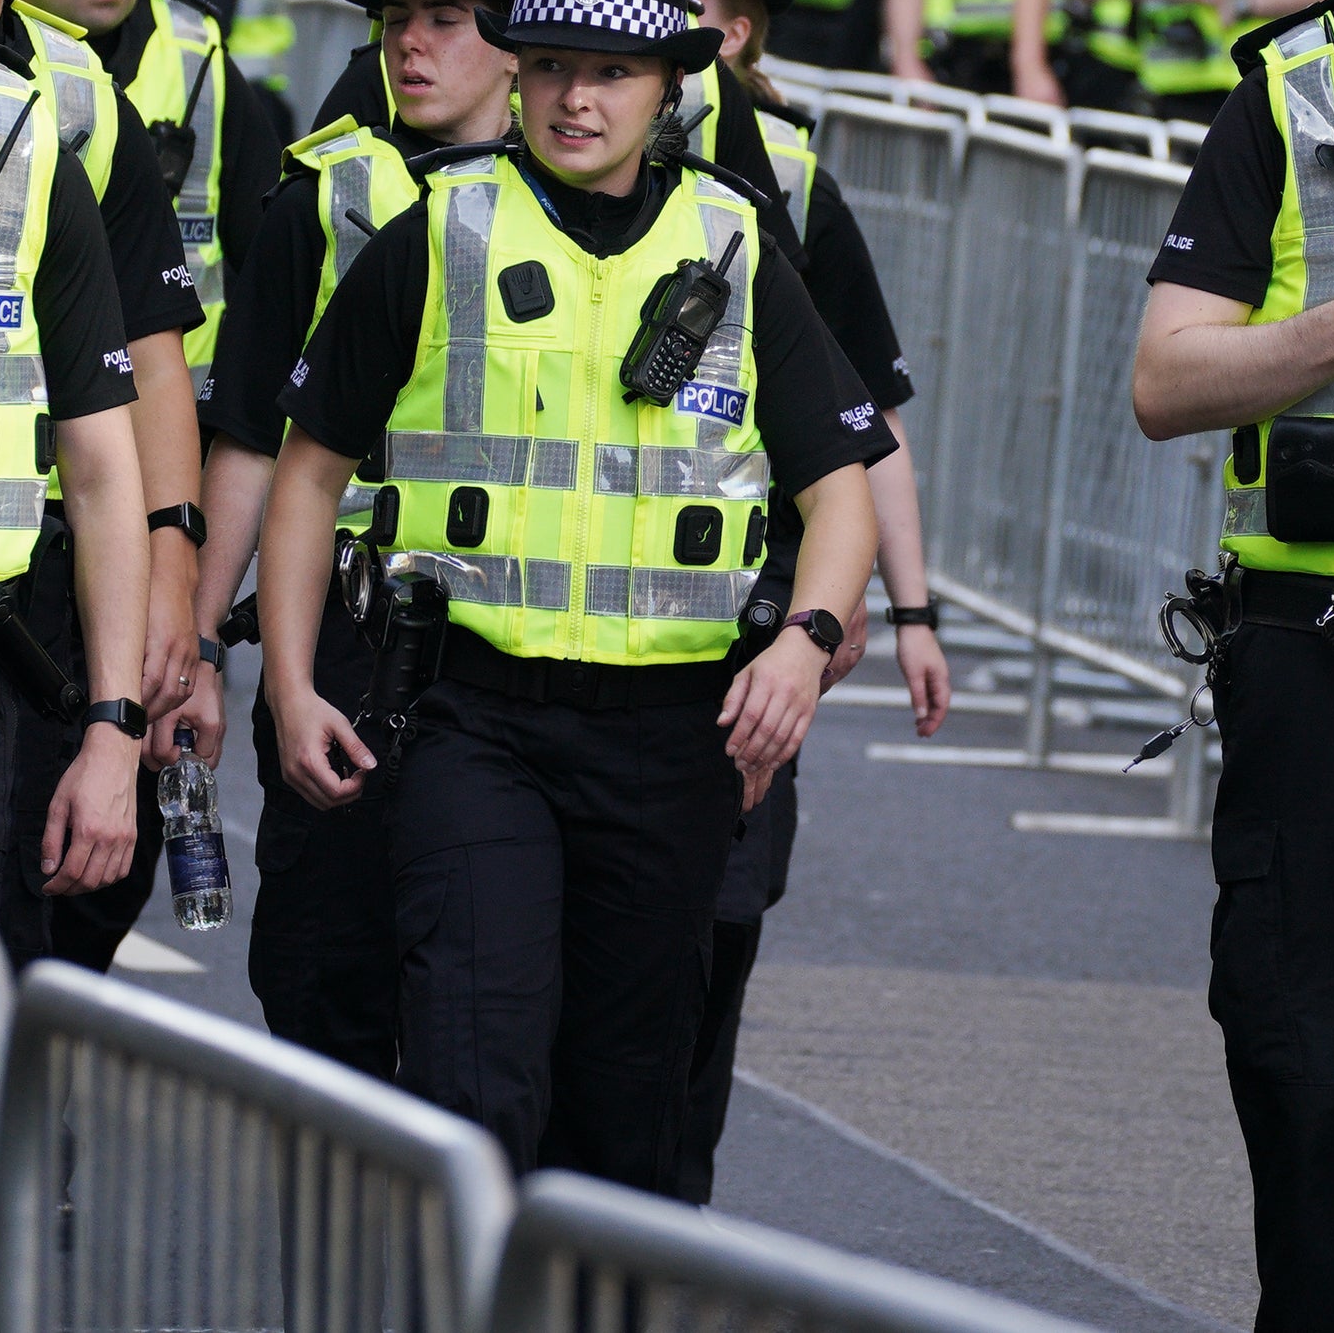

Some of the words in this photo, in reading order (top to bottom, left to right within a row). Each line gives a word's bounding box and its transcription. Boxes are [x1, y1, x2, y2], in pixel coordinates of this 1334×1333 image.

[161, 265, 192, 285] POIL
[103, 348, 130, 368] POIL
[682, 385, 745, 421] POLICE
[839, 402, 875, 426] POILEAS
[852, 418, 872, 432] ALBA
